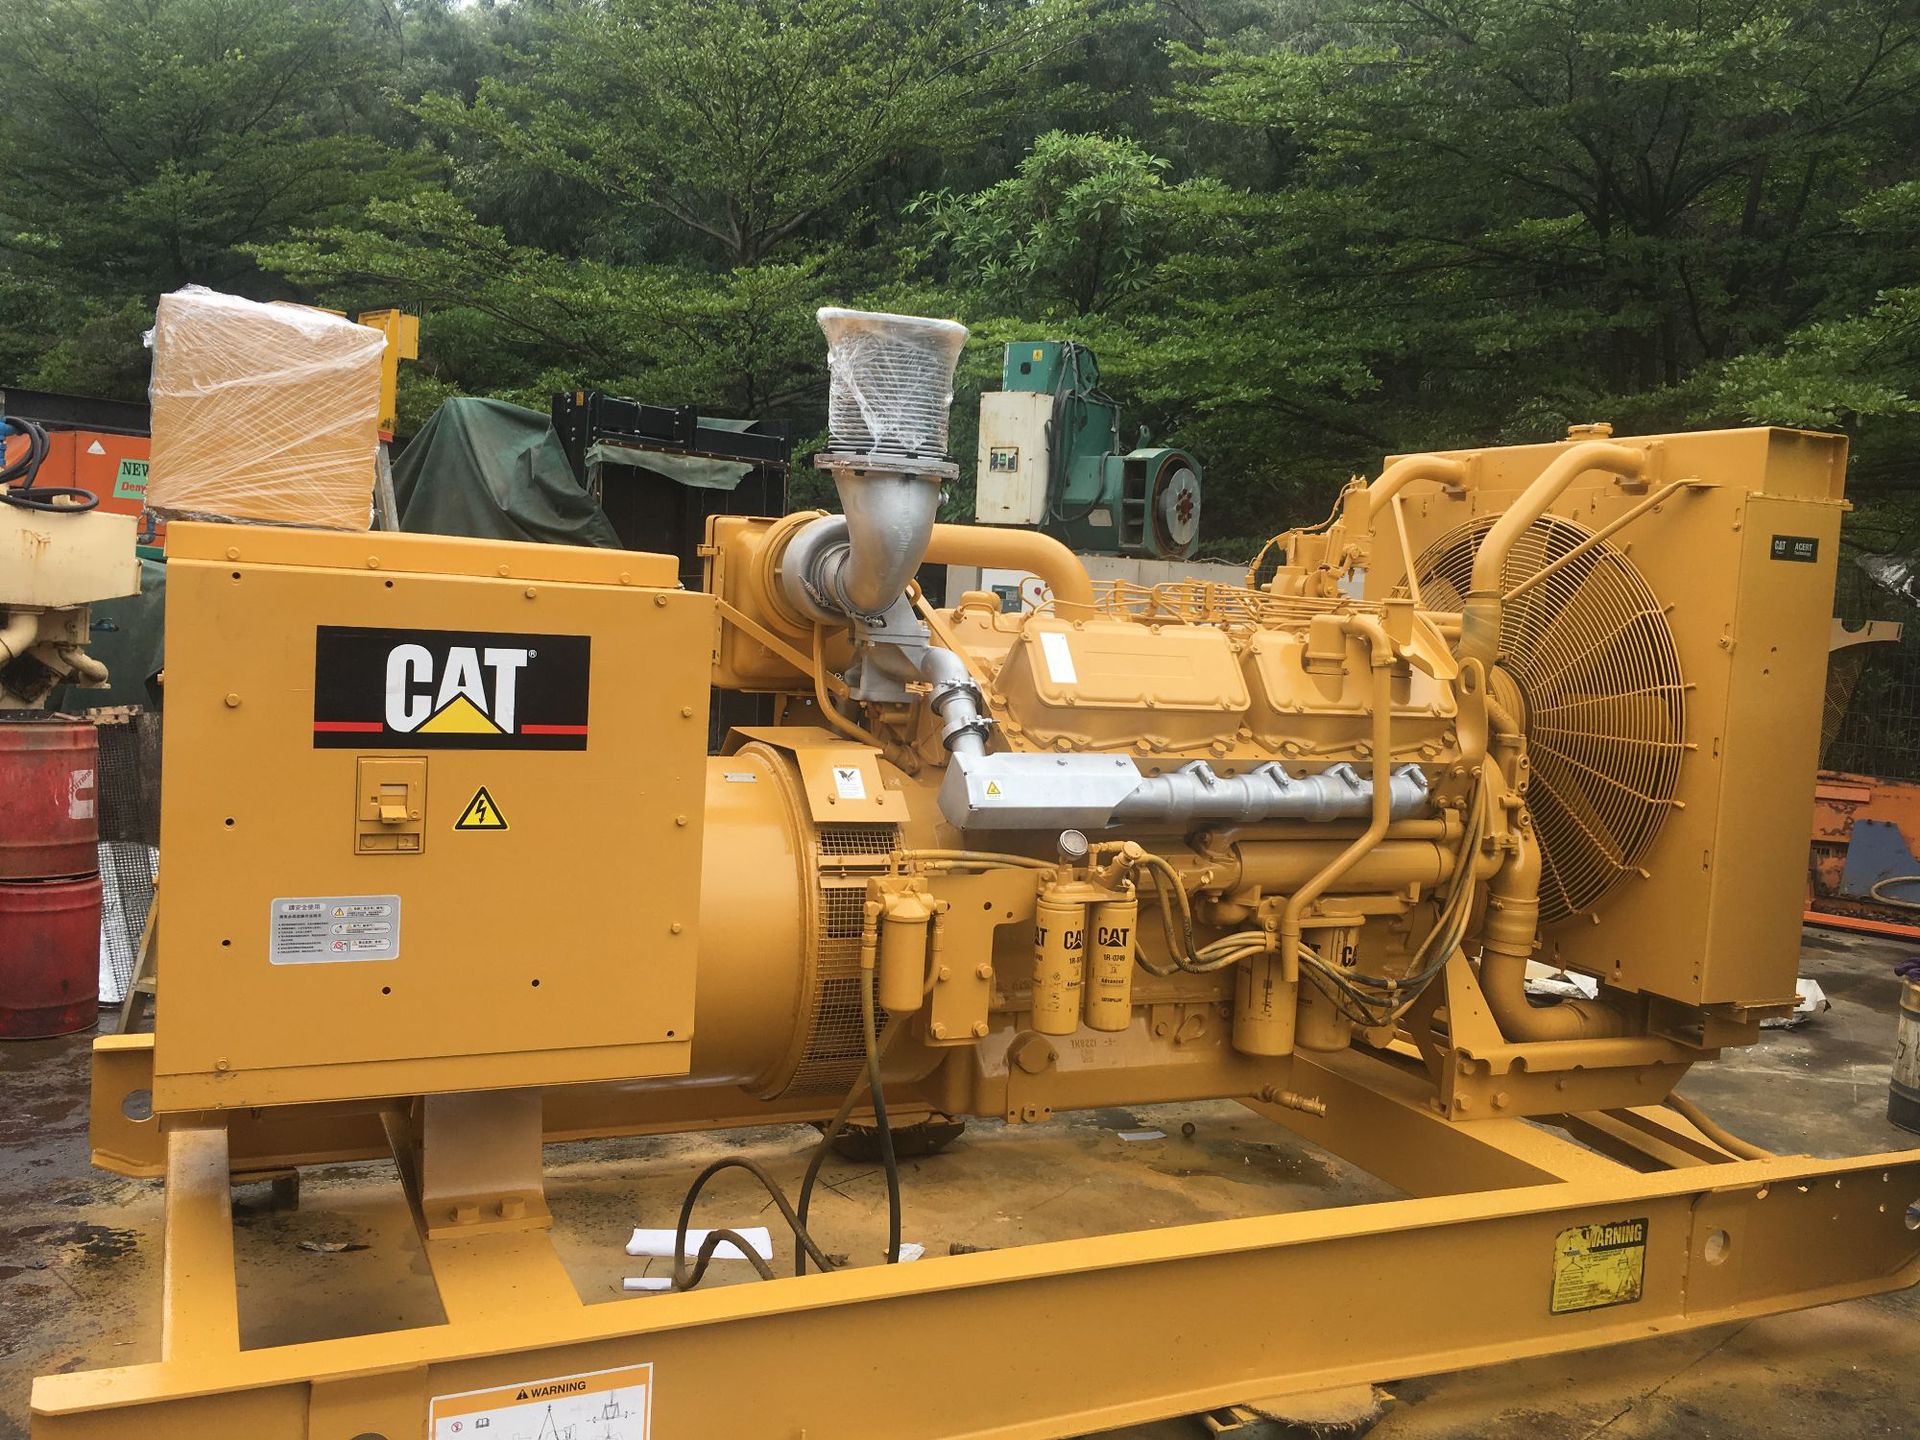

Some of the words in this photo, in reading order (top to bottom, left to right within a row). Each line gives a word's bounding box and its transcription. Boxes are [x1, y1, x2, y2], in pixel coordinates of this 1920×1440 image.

[1774, 540, 1787, 550] CAT
[1794, 542, 1813, 551] ACERT
[1063, 929, 1084, 950] CA
[1097, 926, 1130, 948] CAT
[1341, 943, 1359, 967] CA
[531, 1380, 587, 1399] WARNING
